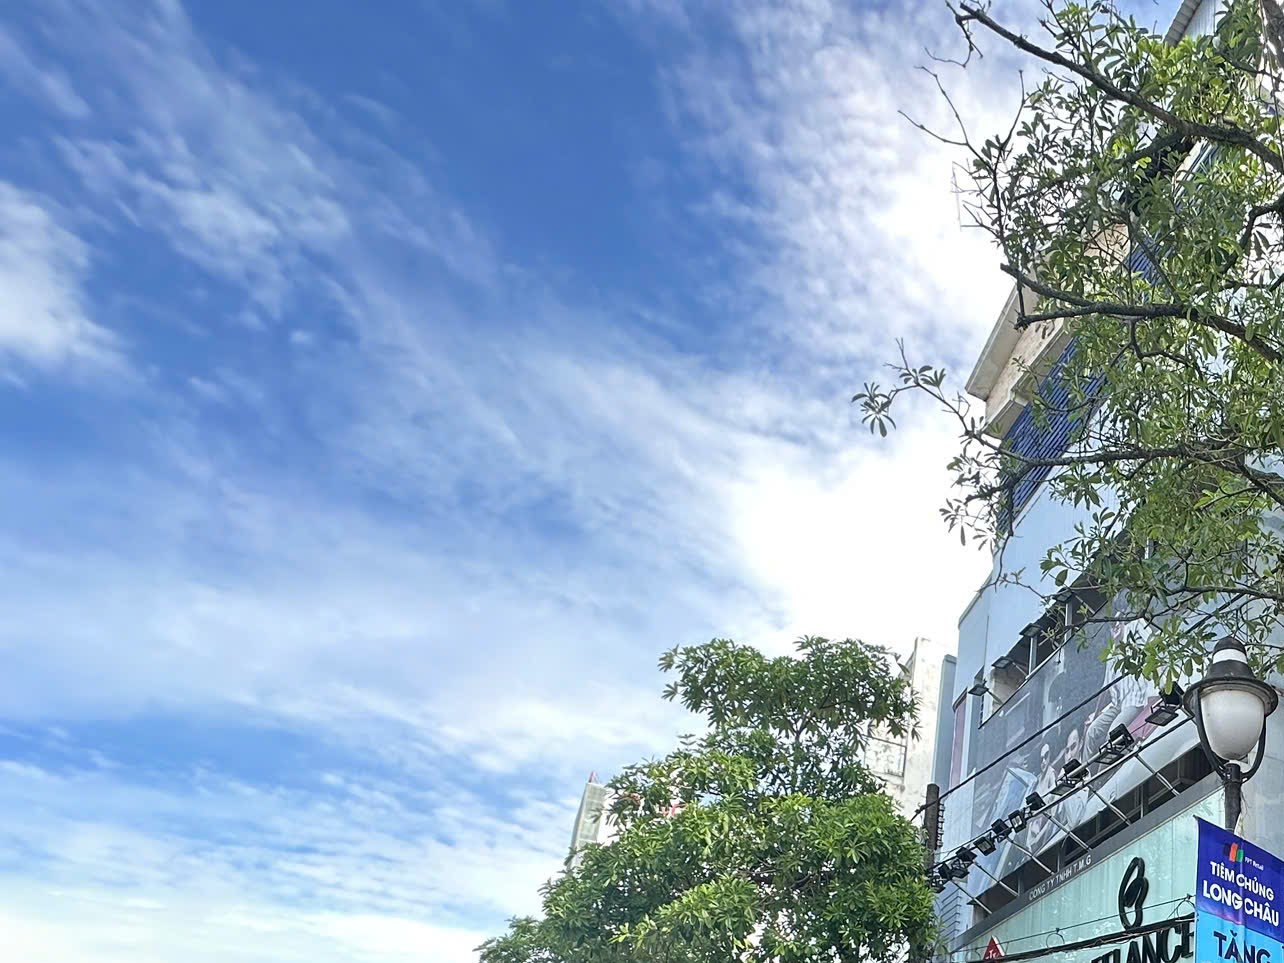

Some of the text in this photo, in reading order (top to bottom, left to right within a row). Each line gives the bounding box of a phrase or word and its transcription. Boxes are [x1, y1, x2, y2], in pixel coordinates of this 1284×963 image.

[1046, 877, 1055, 889] TY
[1055, 868, 1072, 883] TNHH
[1210, 861, 1275, 901] TIÊM CHỦNG
[1203, 880, 1279, 927] LONG CHÂU
